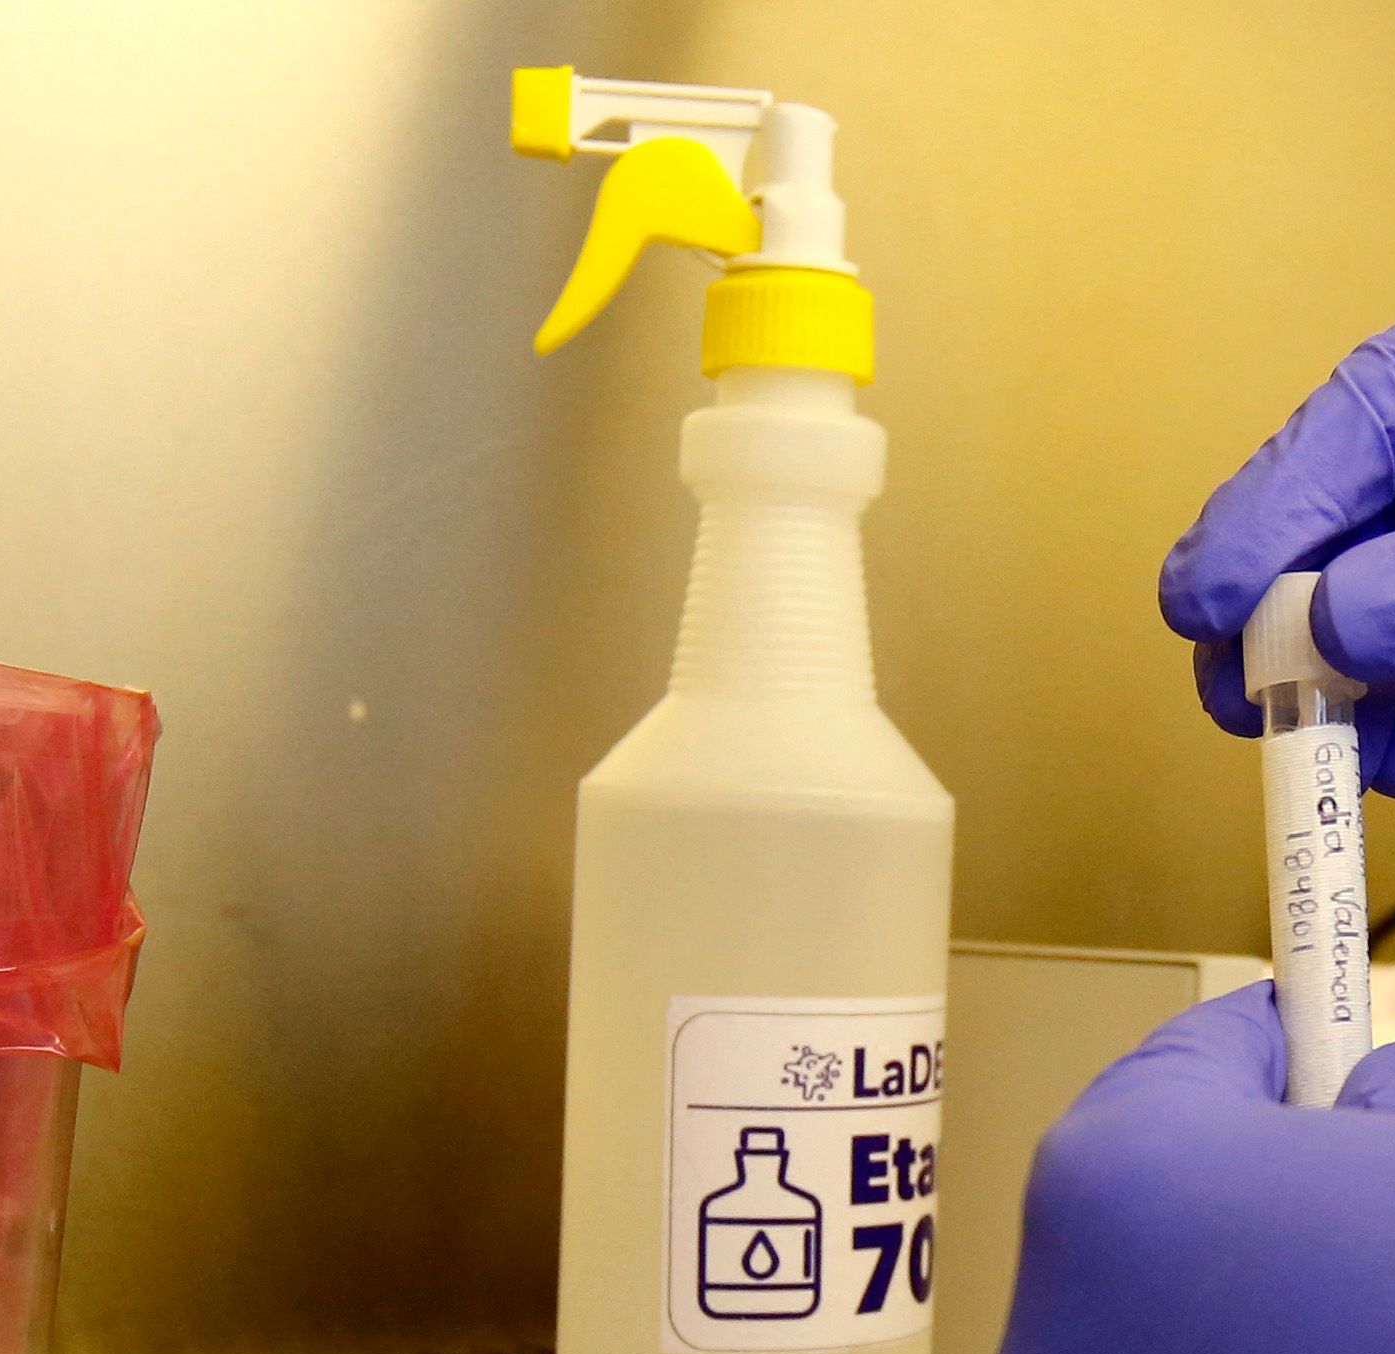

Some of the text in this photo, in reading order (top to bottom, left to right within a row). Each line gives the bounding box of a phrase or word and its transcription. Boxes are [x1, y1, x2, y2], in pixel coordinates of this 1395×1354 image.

[1284, 830, 1318, 953] 184801
[1330, 887, 1363, 1023] Valencia
[853, 1213, 934, 1315] 70
